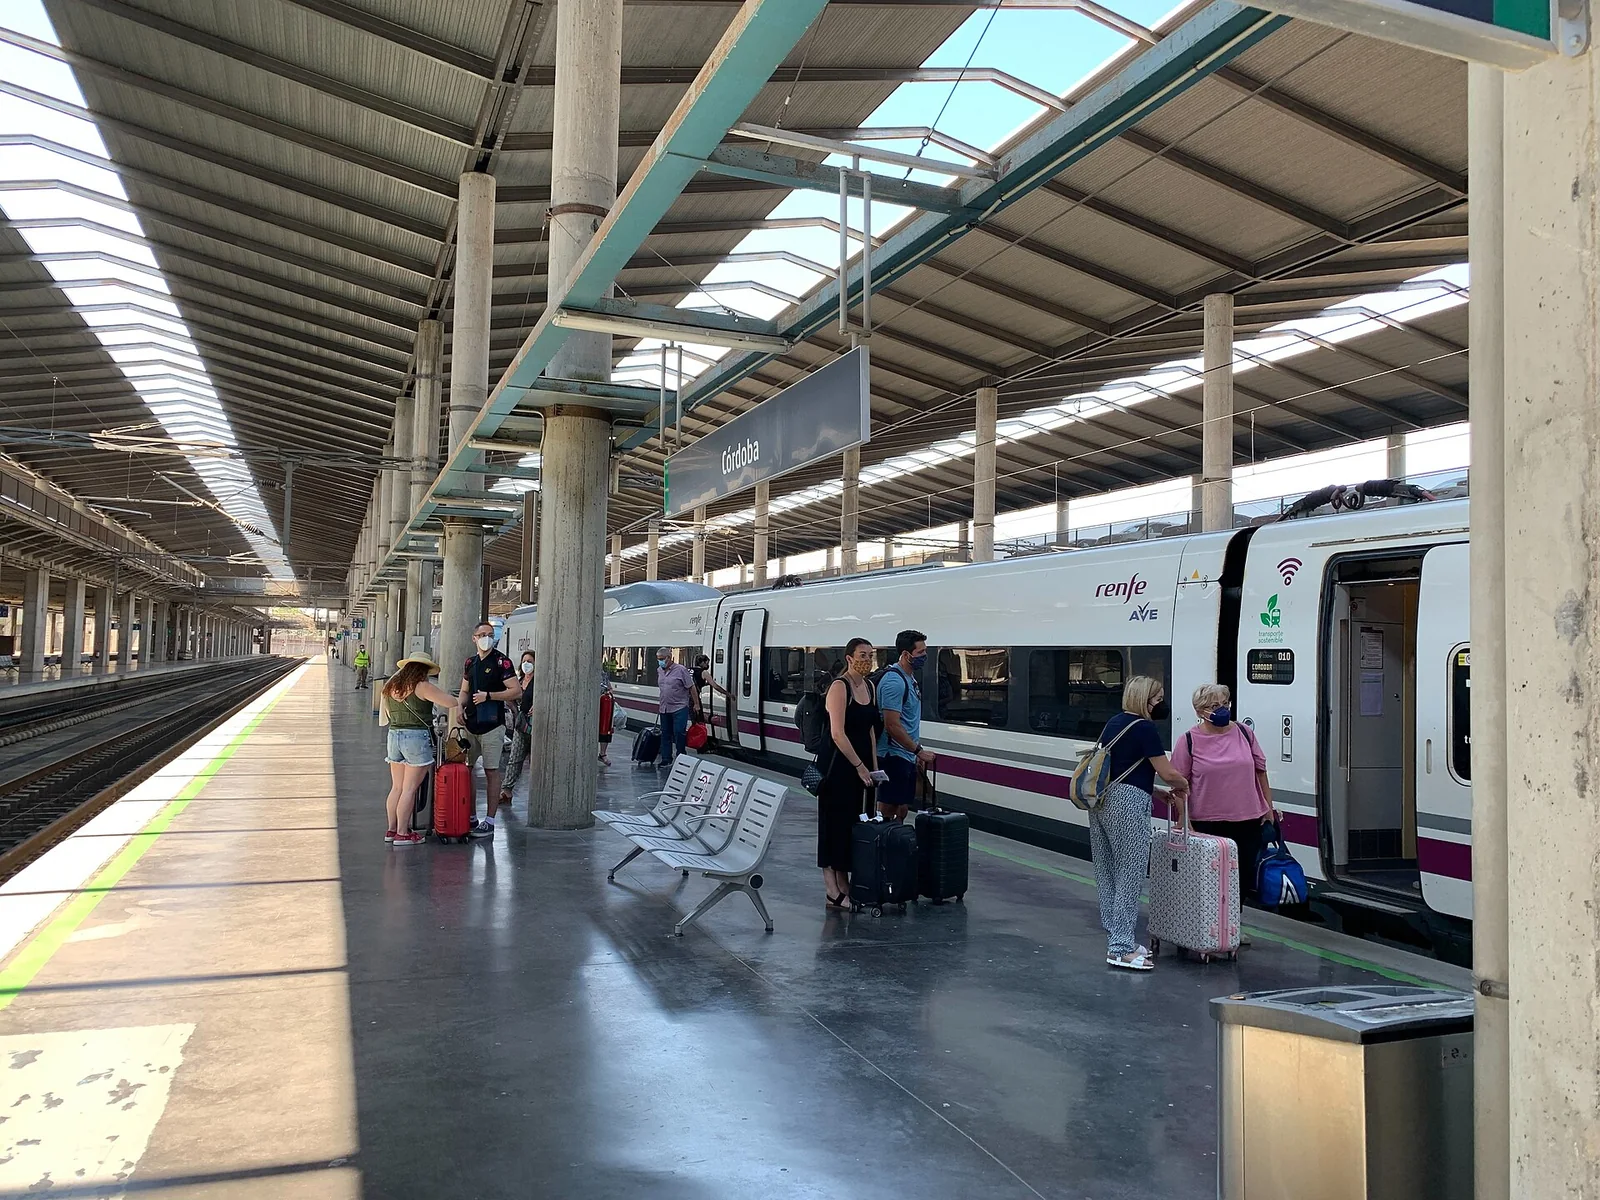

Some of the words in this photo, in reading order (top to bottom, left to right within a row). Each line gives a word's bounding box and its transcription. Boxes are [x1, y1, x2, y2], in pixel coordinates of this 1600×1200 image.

[721, 438, 759, 475] Córdoba
[1095, 572, 1147, 605] renfe
[1129, 601, 1158, 622] AVE
[1278, 652, 1290, 661] 010
